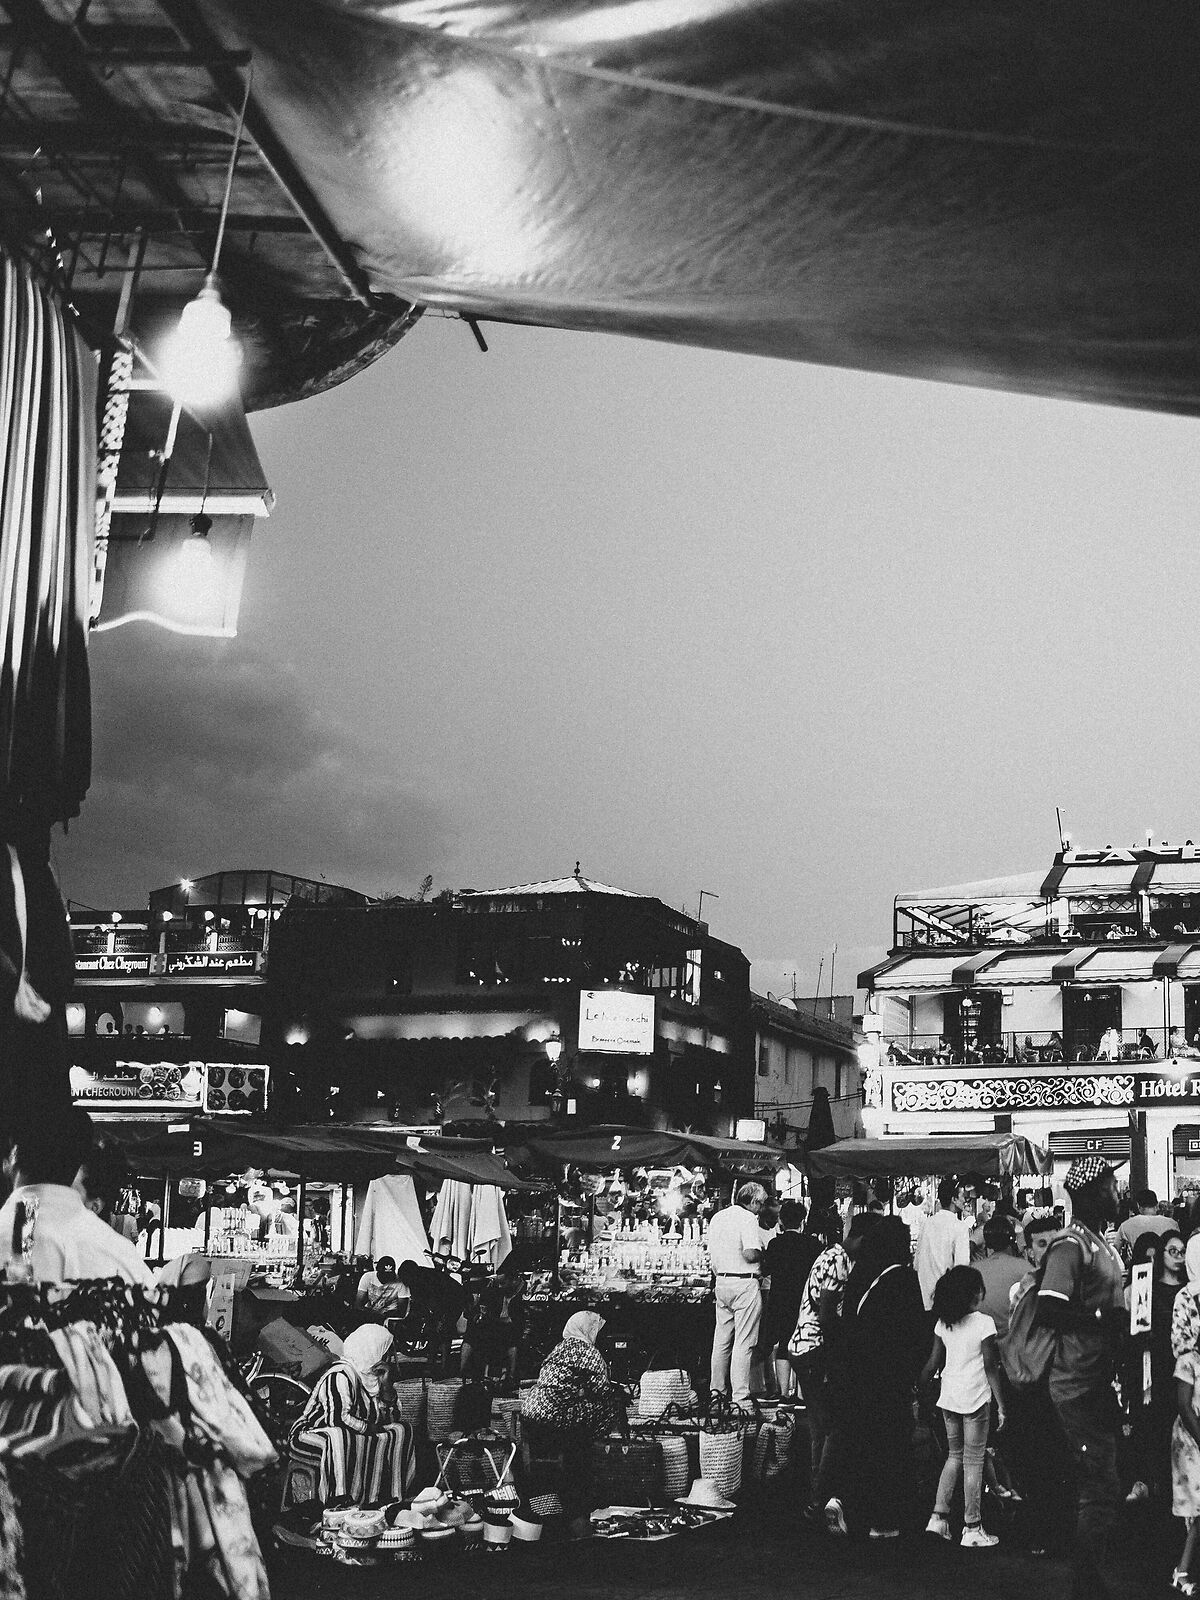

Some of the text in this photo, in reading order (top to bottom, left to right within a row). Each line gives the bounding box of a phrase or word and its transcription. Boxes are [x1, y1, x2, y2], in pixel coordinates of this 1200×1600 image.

[99, 956, 115, 970] Chez
[115, 956, 148, 973] Chegrouni
[225, 955, 253, 971] مطعم
[85, 1086, 137, 1097] CHEGROUNI
[1140, 1076, 1188, 1098] Hôtel
[193, 1141, 202, 1156] 3
[611, 1135, 622, 1150] 2
[1087, 1140, 1103, 1150] CF
